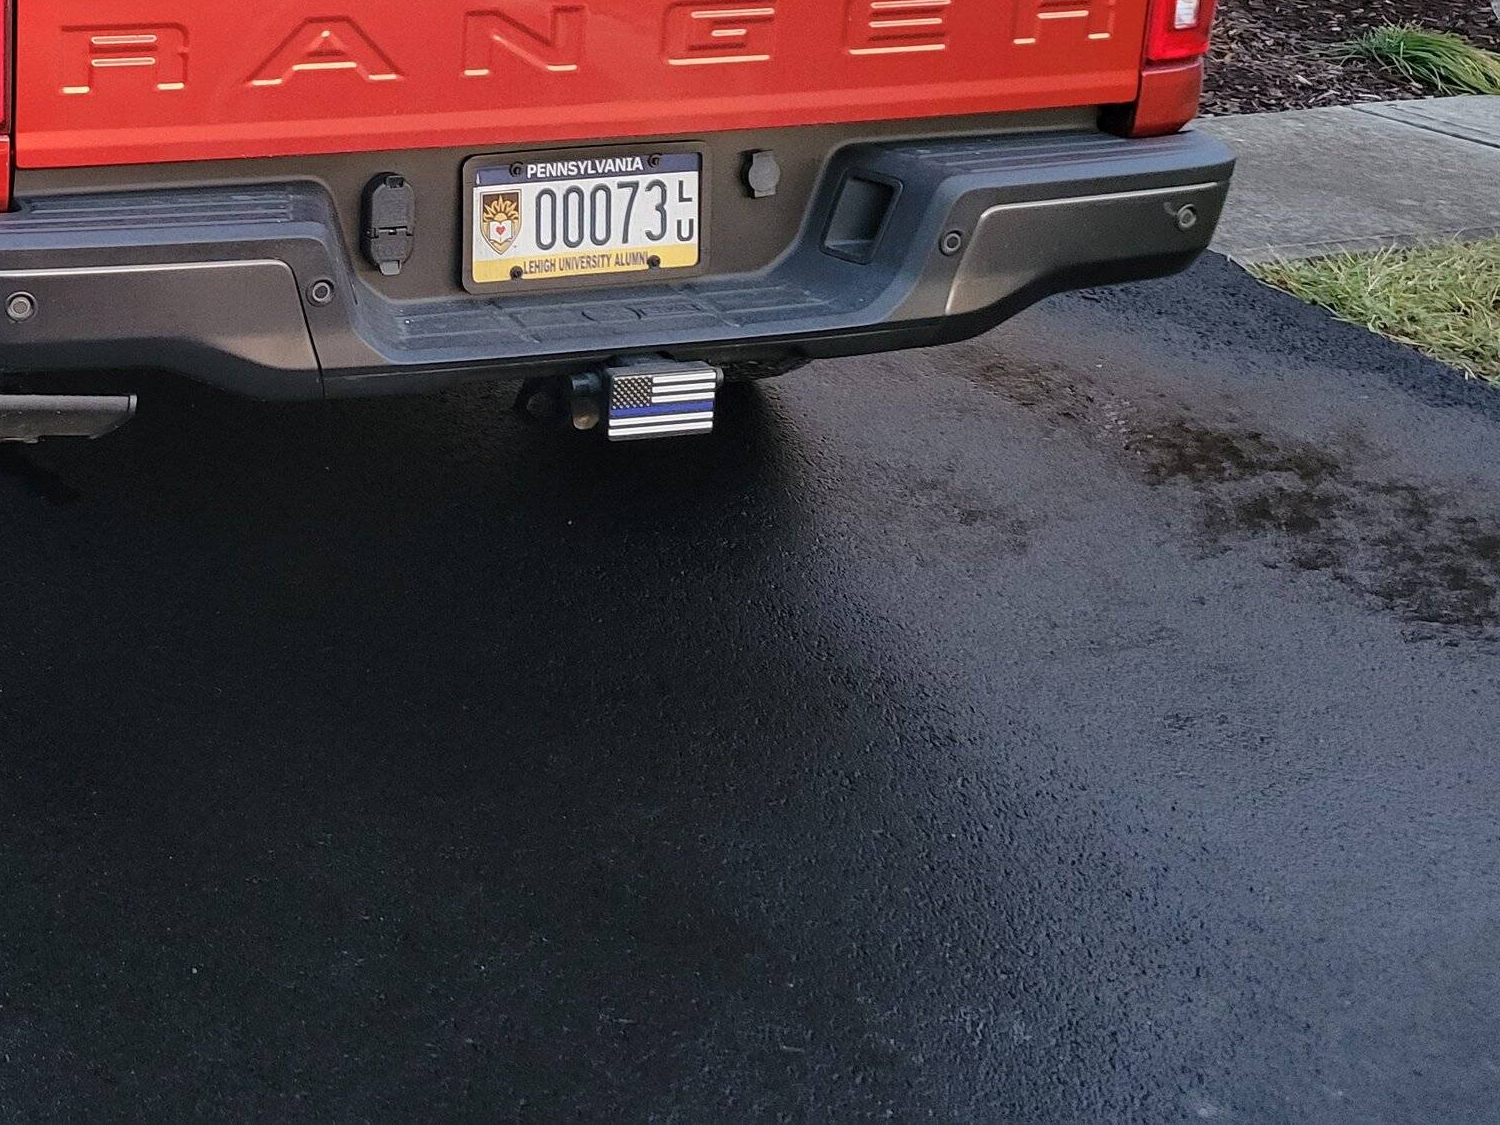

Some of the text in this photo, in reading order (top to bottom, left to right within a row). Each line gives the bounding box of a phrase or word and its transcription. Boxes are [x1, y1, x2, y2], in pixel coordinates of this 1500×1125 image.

[526, 156, 644, 179] PENNSYLVANIA
[534, 179, 668, 251] 00073
[523, 251, 649, 275] LEHIGH UNIVERSITY ALUMNI
